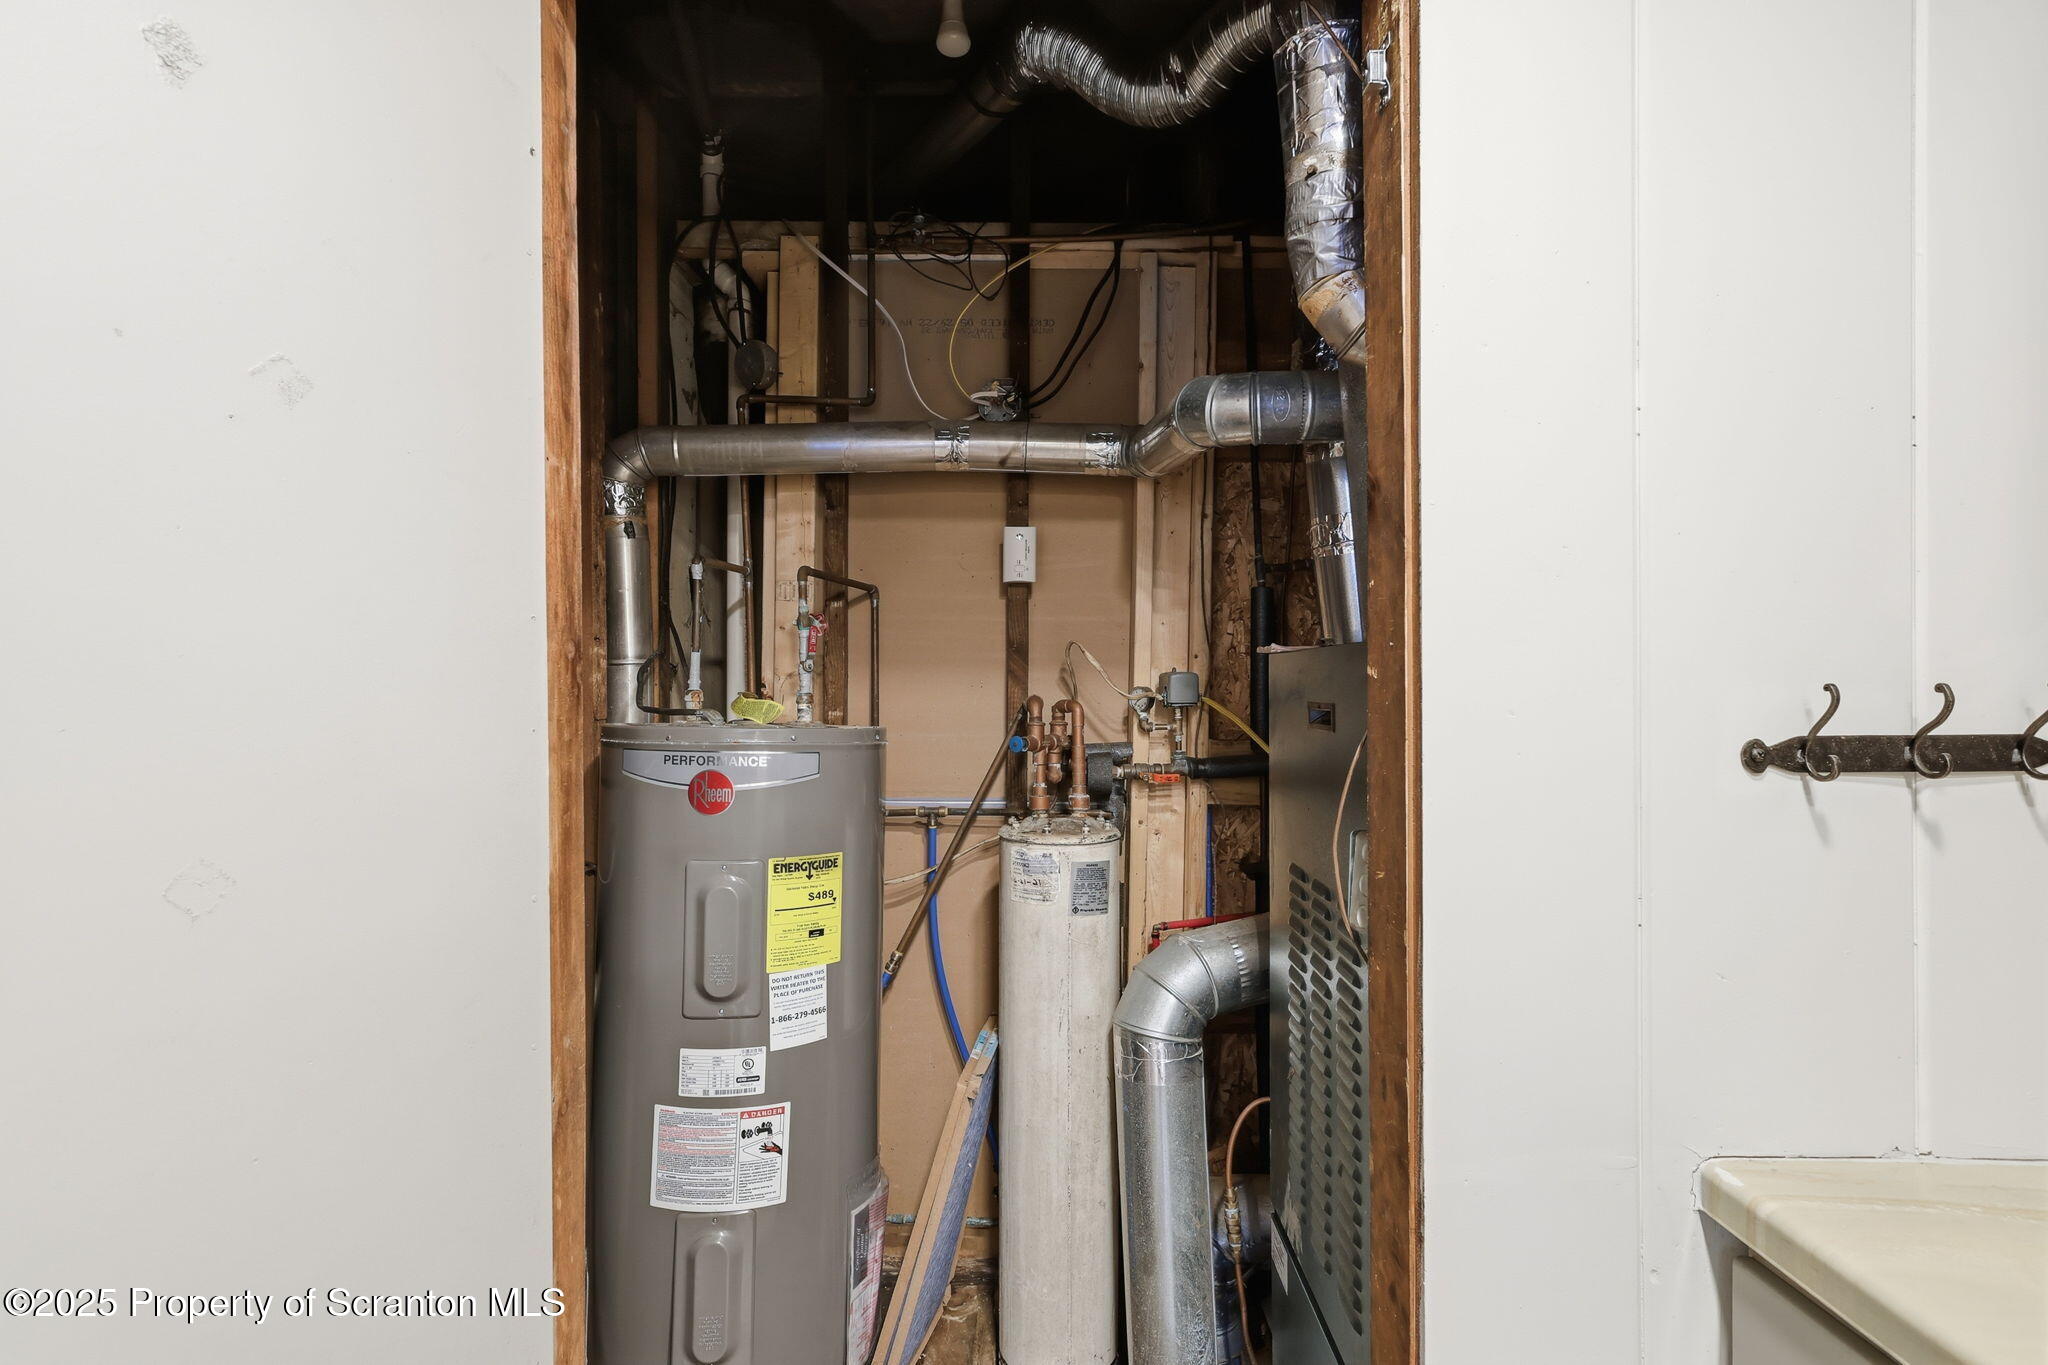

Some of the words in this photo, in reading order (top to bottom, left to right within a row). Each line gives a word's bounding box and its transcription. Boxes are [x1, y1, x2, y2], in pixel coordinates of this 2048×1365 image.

[663, 754, 767, 767] PERFORMANCE
[693, 771, 732, 808] Rheem
[773, 858, 838, 875] ENERGYGUIDE
[808, 890, 834, 901] $489
[798, 985, 823, 993] PURCHASE
[771, 1006, 826, 1024] 1-866-279-4566
[751, 1107, 783, 1118] DANGER
